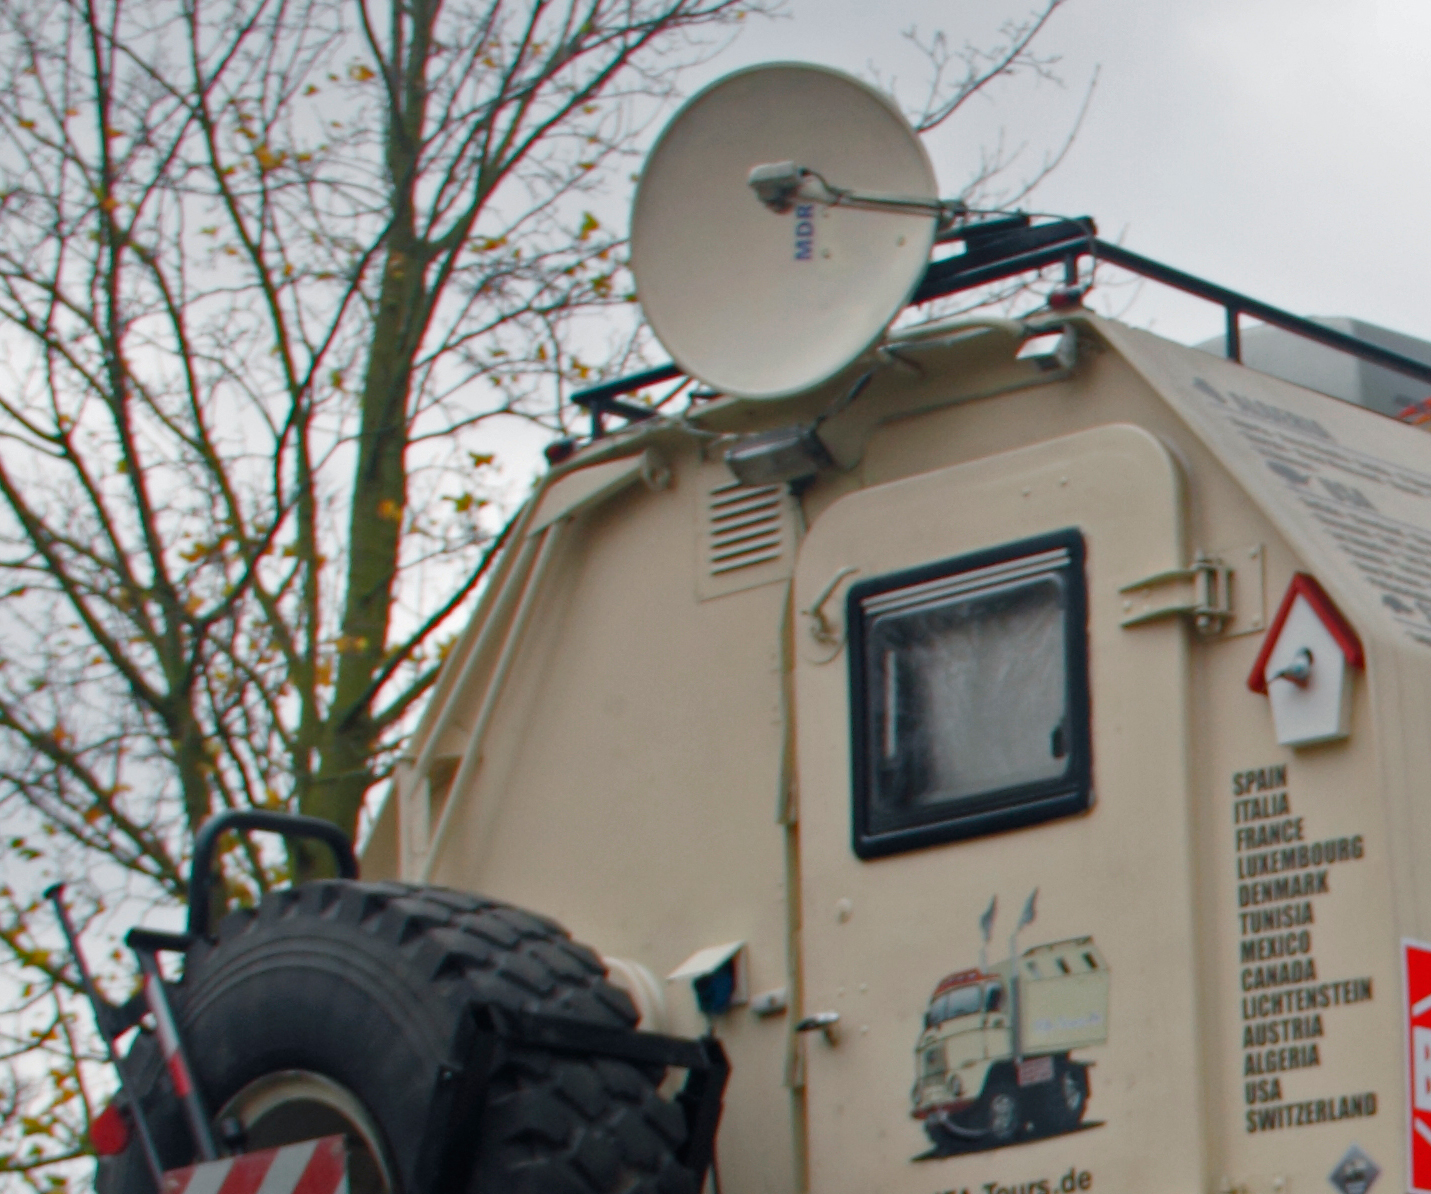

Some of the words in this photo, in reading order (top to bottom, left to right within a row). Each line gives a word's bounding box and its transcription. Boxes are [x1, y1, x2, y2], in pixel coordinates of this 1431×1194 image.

[794, 203, 814, 260] MDR
[1233, 764, 1288, 797] SPAIN
[1234, 793, 1290, 824] ITALIA
[1235, 817, 1304, 851] FRANCE
[1237, 834, 1364, 880] LUXEMBOURG
[1238, 868, 1329, 908] DENMARK
[1239, 901, 1314, 936] TUNISIA
[1240, 930, 1311, 964] MEXICO
[1241, 958, 1316, 992] CANADA
[1242, 977, 1373, 1021] LICHTENSTEIN
[1242, 1014, 1324, 1049] AUSTRIA
[1244, 1044, 1320, 1077] ALGERIA
[1245, 1077, 1282, 1105] USA
[1245, 1092, 1378, 1134] SWITZERLAND
